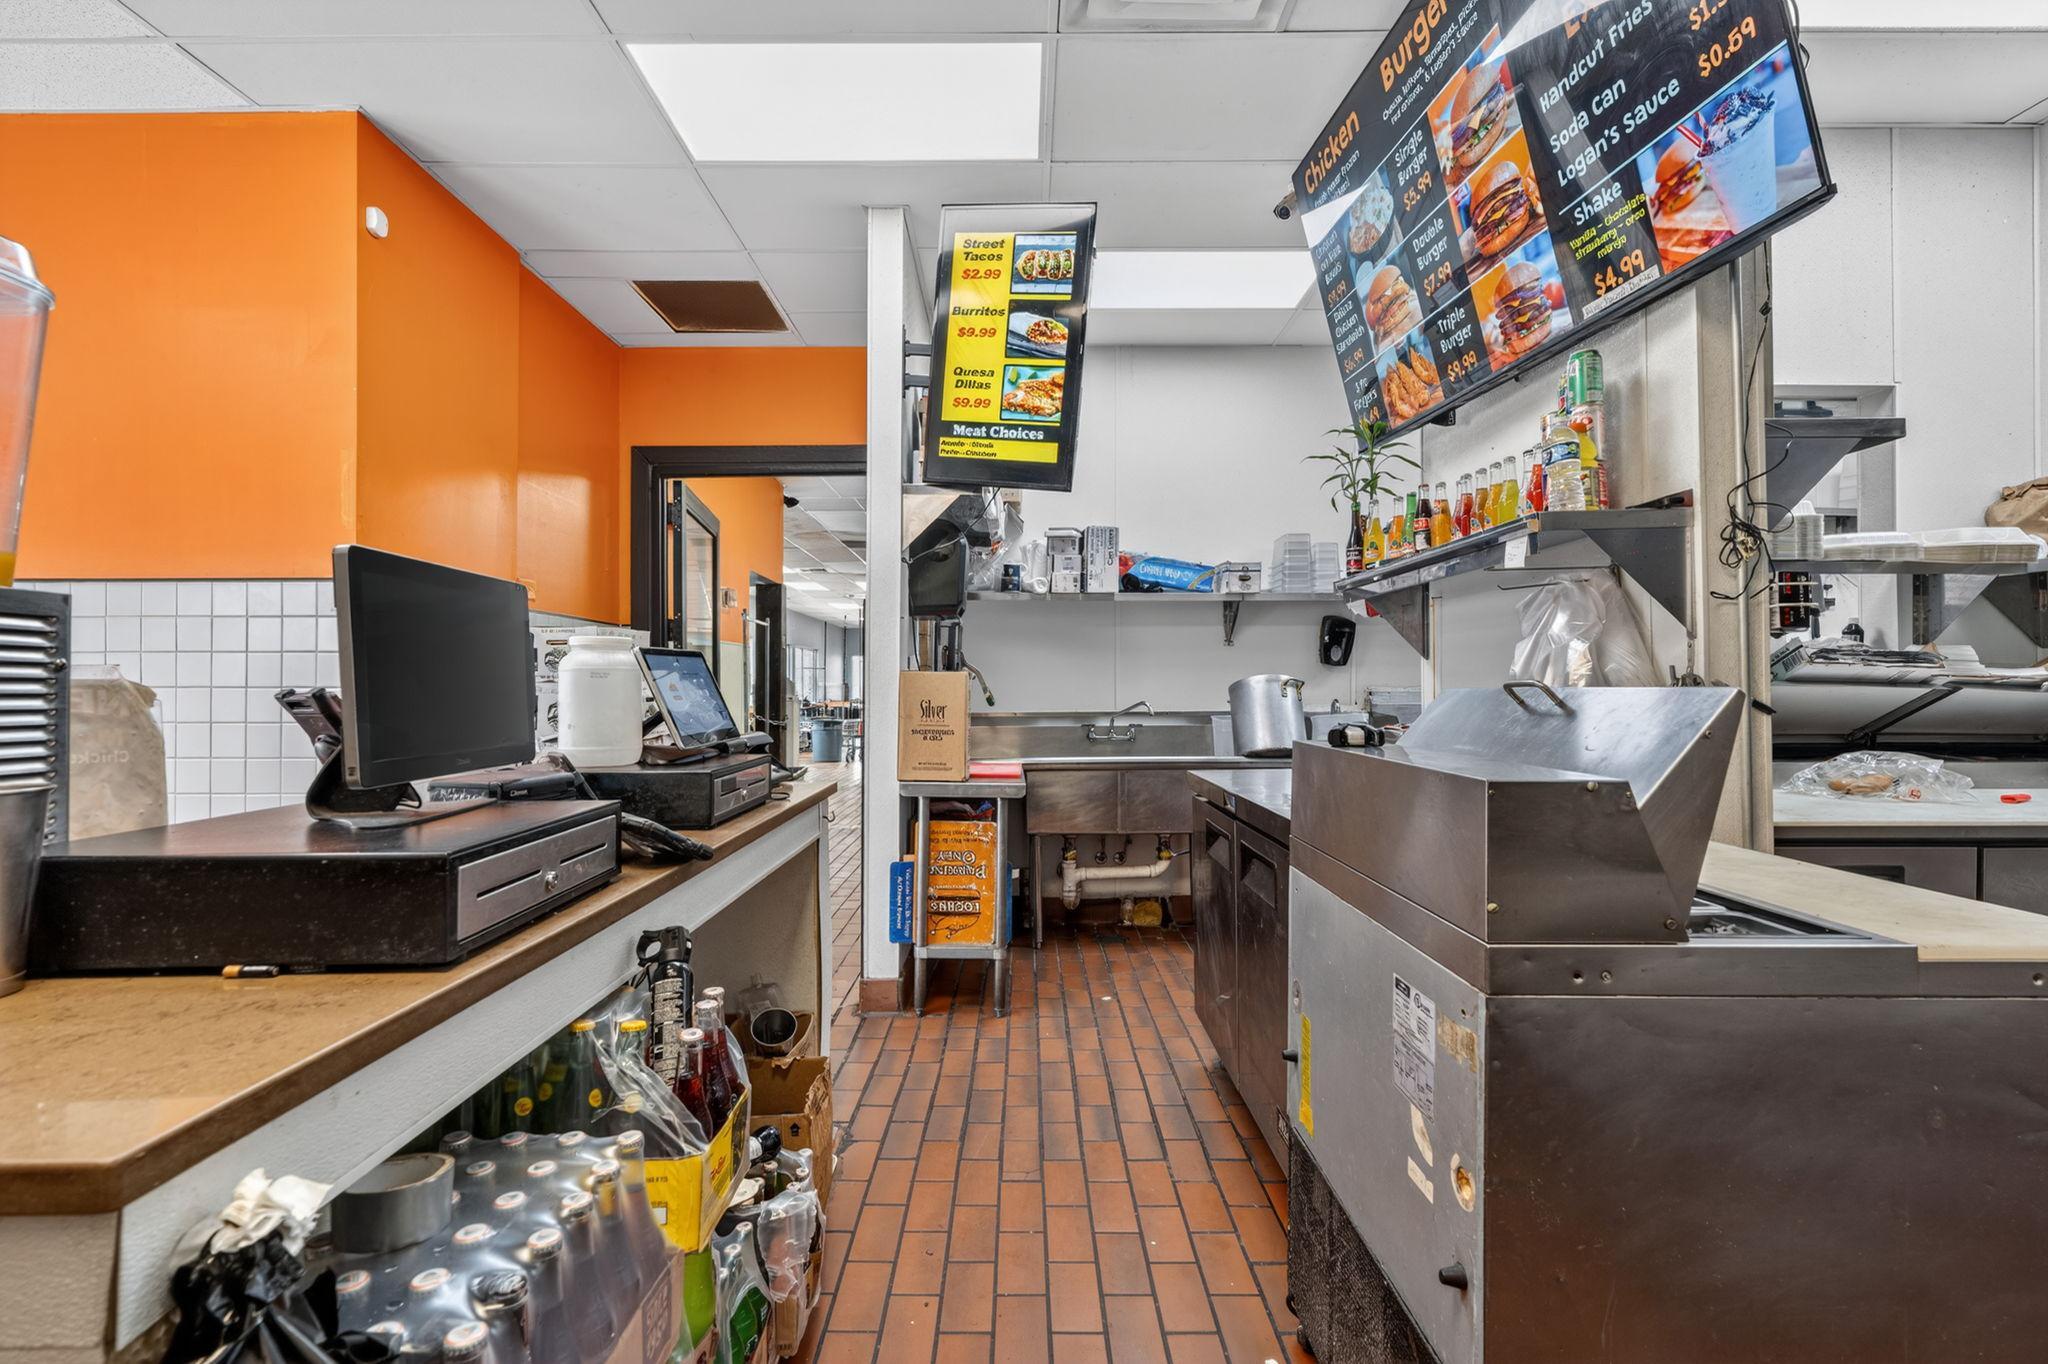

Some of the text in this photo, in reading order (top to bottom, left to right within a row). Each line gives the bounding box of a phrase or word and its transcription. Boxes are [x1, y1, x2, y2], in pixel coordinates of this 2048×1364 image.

[1539, 38, 1606, 114] Handcut
[1609, 0, 1654, 49] Fries
[1550, 78, 1627, 155] Soda Can
[1395, 130, 1423, 167] Single
[1558, 78, 1681, 188] Logan's Sauce
[1305, 111, 1360, 194] Chicken
[1398, 146, 1427, 186] Burger
[1403, 170, 1432, 211] $5.99
[1574, 182, 1623, 226] Shake
[963, 239, 1005, 249] Street
[1412, 217, 1444, 253] Double
[963, 251, 1004, 262] Tacos
[1417, 236, 1448, 271] Burger
[961, 268, 1001, 281] $2.99
[1423, 261, 1452, 297] $7.99
[1594, 249, 1645, 297] $4.99
[952, 306, 1006, 317] Burritos
[1437, 306, 1466, 334] Triple
[957, 327, 997, 339] $9.99
[1440, 323, 1473, 354] Burger
[953, 366, 995, 378] Quesa
[1447, 351, 1479, 383] $9.99
[955, 378, 992, 390] Dillas
[952, 397, 991, 409] $9.99
[953, 424, 1044, 440] Meat Choices
[920, 699, 948, 719] Silver
